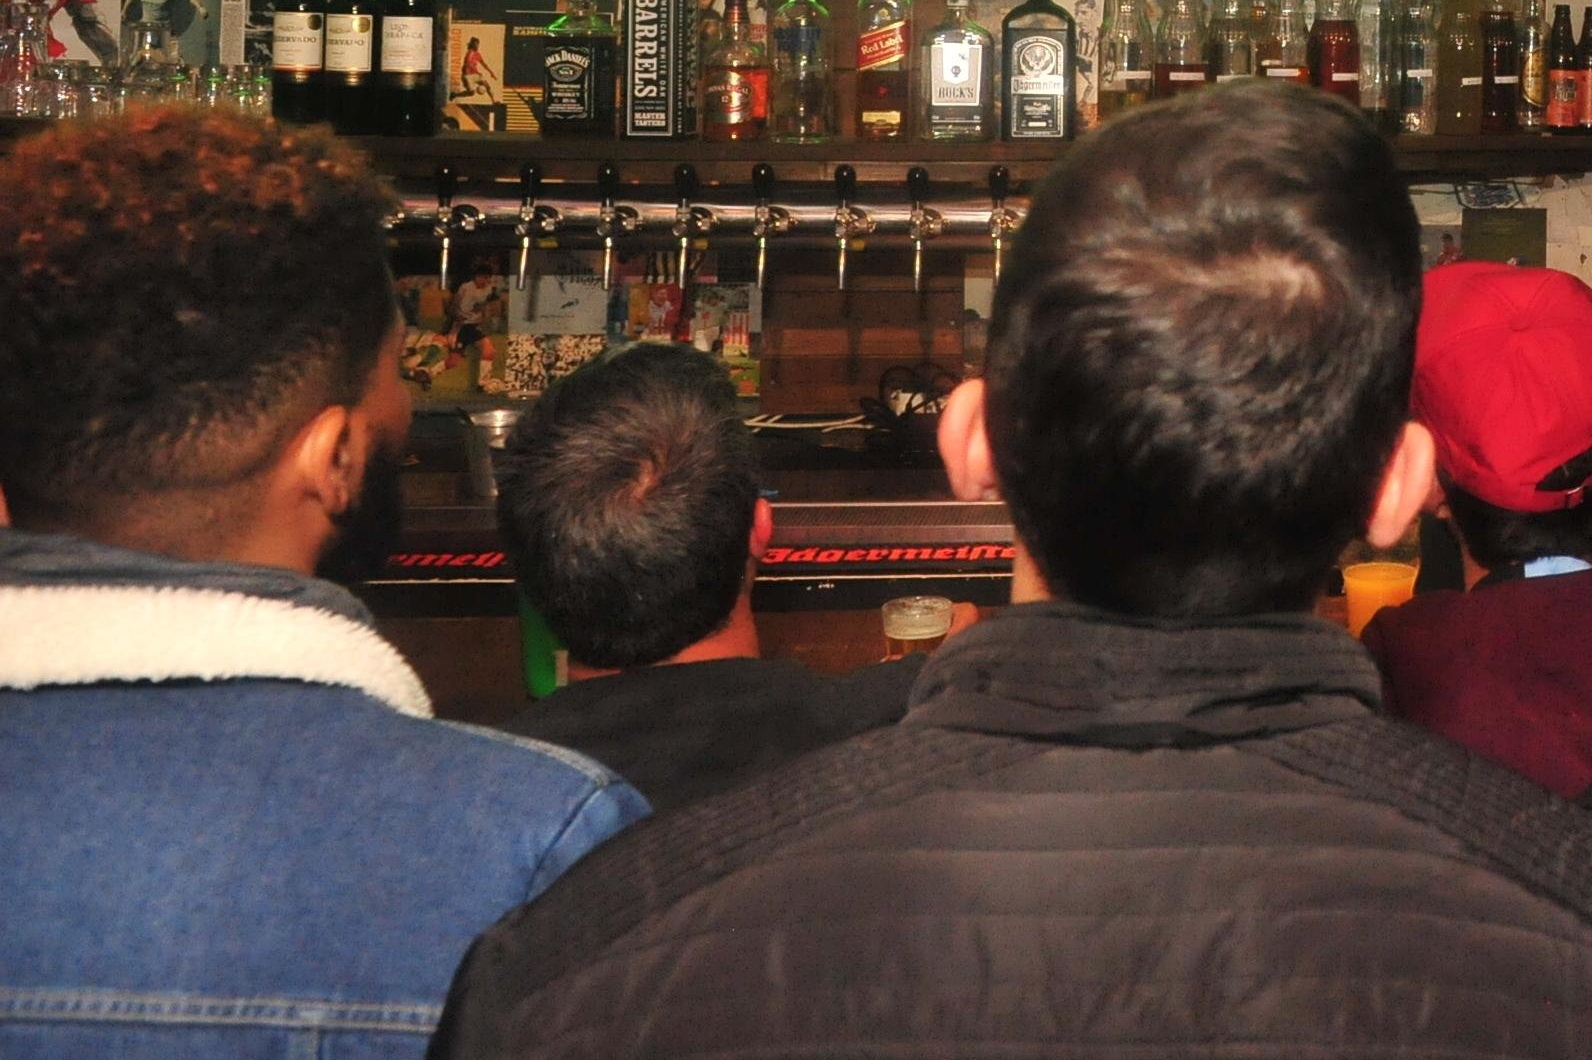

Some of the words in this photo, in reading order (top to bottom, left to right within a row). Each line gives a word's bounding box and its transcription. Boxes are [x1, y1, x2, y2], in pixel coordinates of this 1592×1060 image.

[860, 41, 877, 57] Red
[878, 35, 904, 52] Label
[545, 51, 562, 67] JACK
